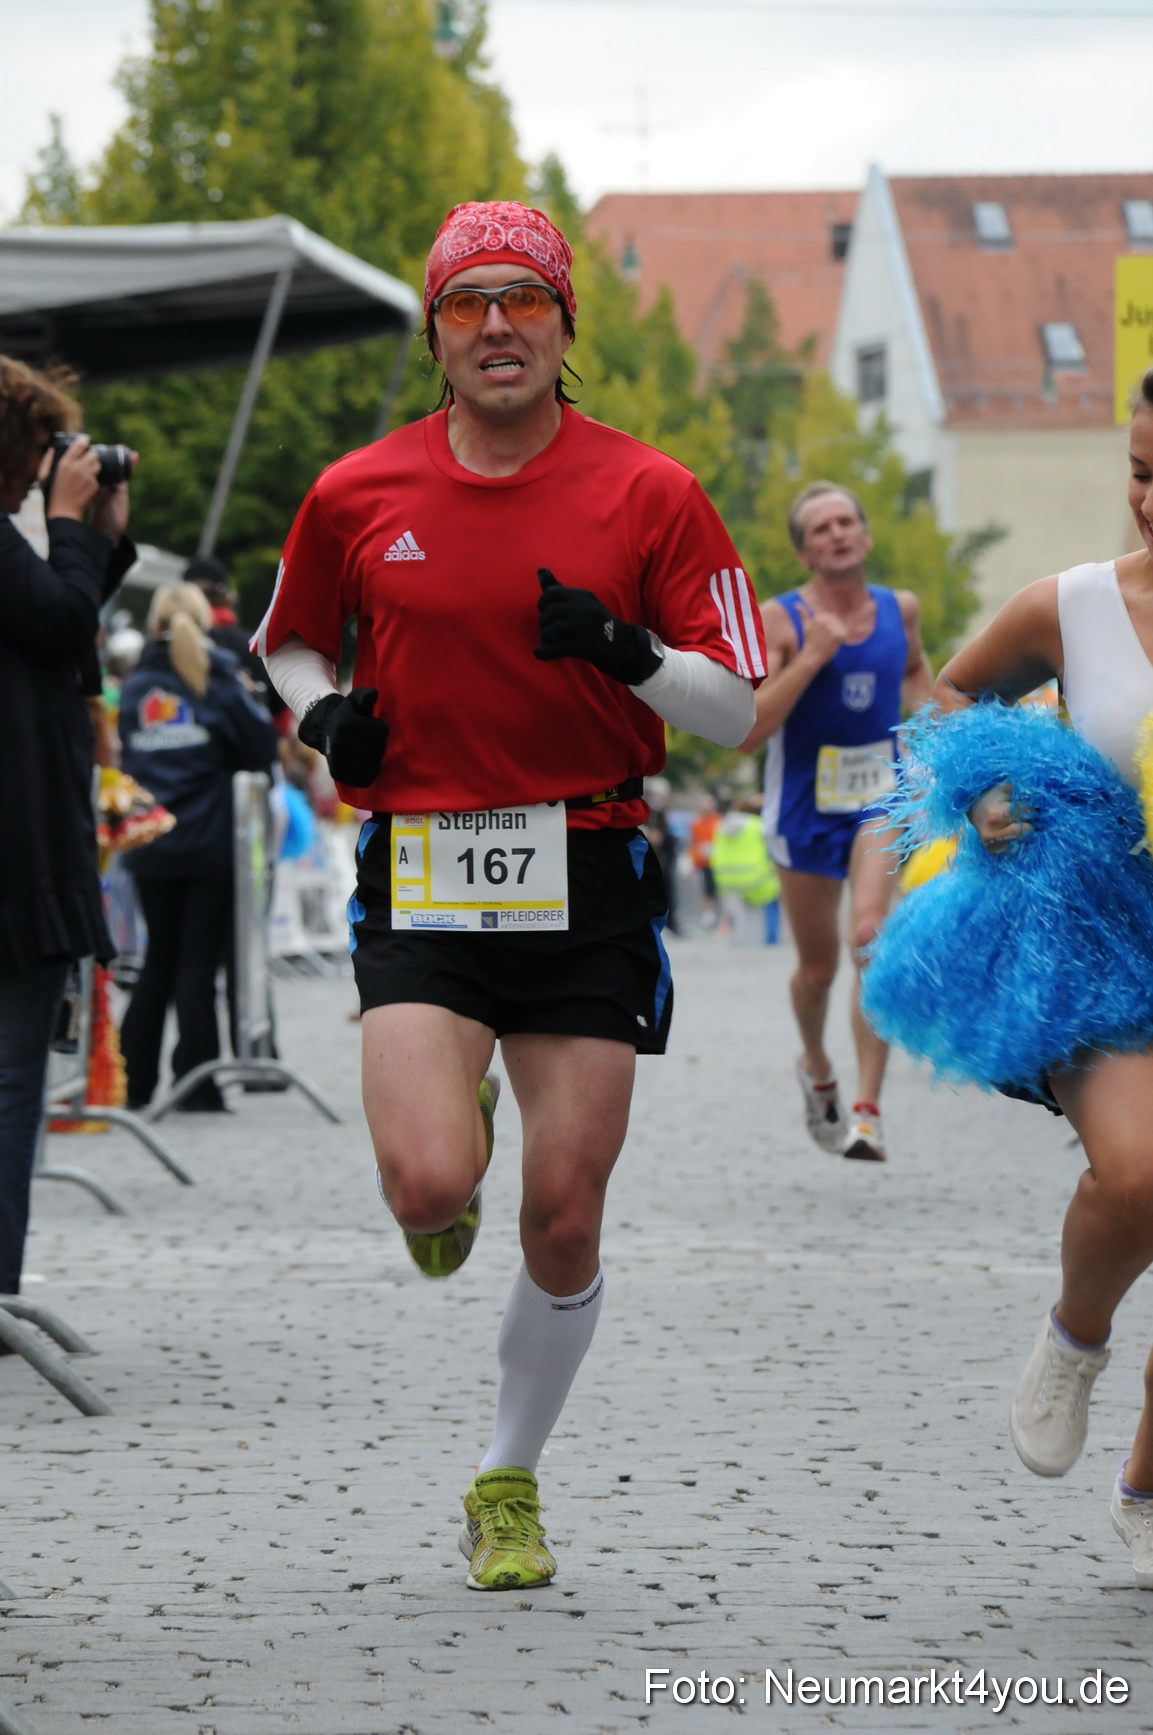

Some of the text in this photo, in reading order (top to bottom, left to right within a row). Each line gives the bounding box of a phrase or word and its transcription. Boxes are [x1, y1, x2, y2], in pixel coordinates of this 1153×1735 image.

[384, 550, 426, 561] adidas
[438, 809, 527, 836] Stephan
[398, 845, 409, 865] A
[457, 847, 536, 885] 167
[500, 910, 565, 922] PFLEIDERER
